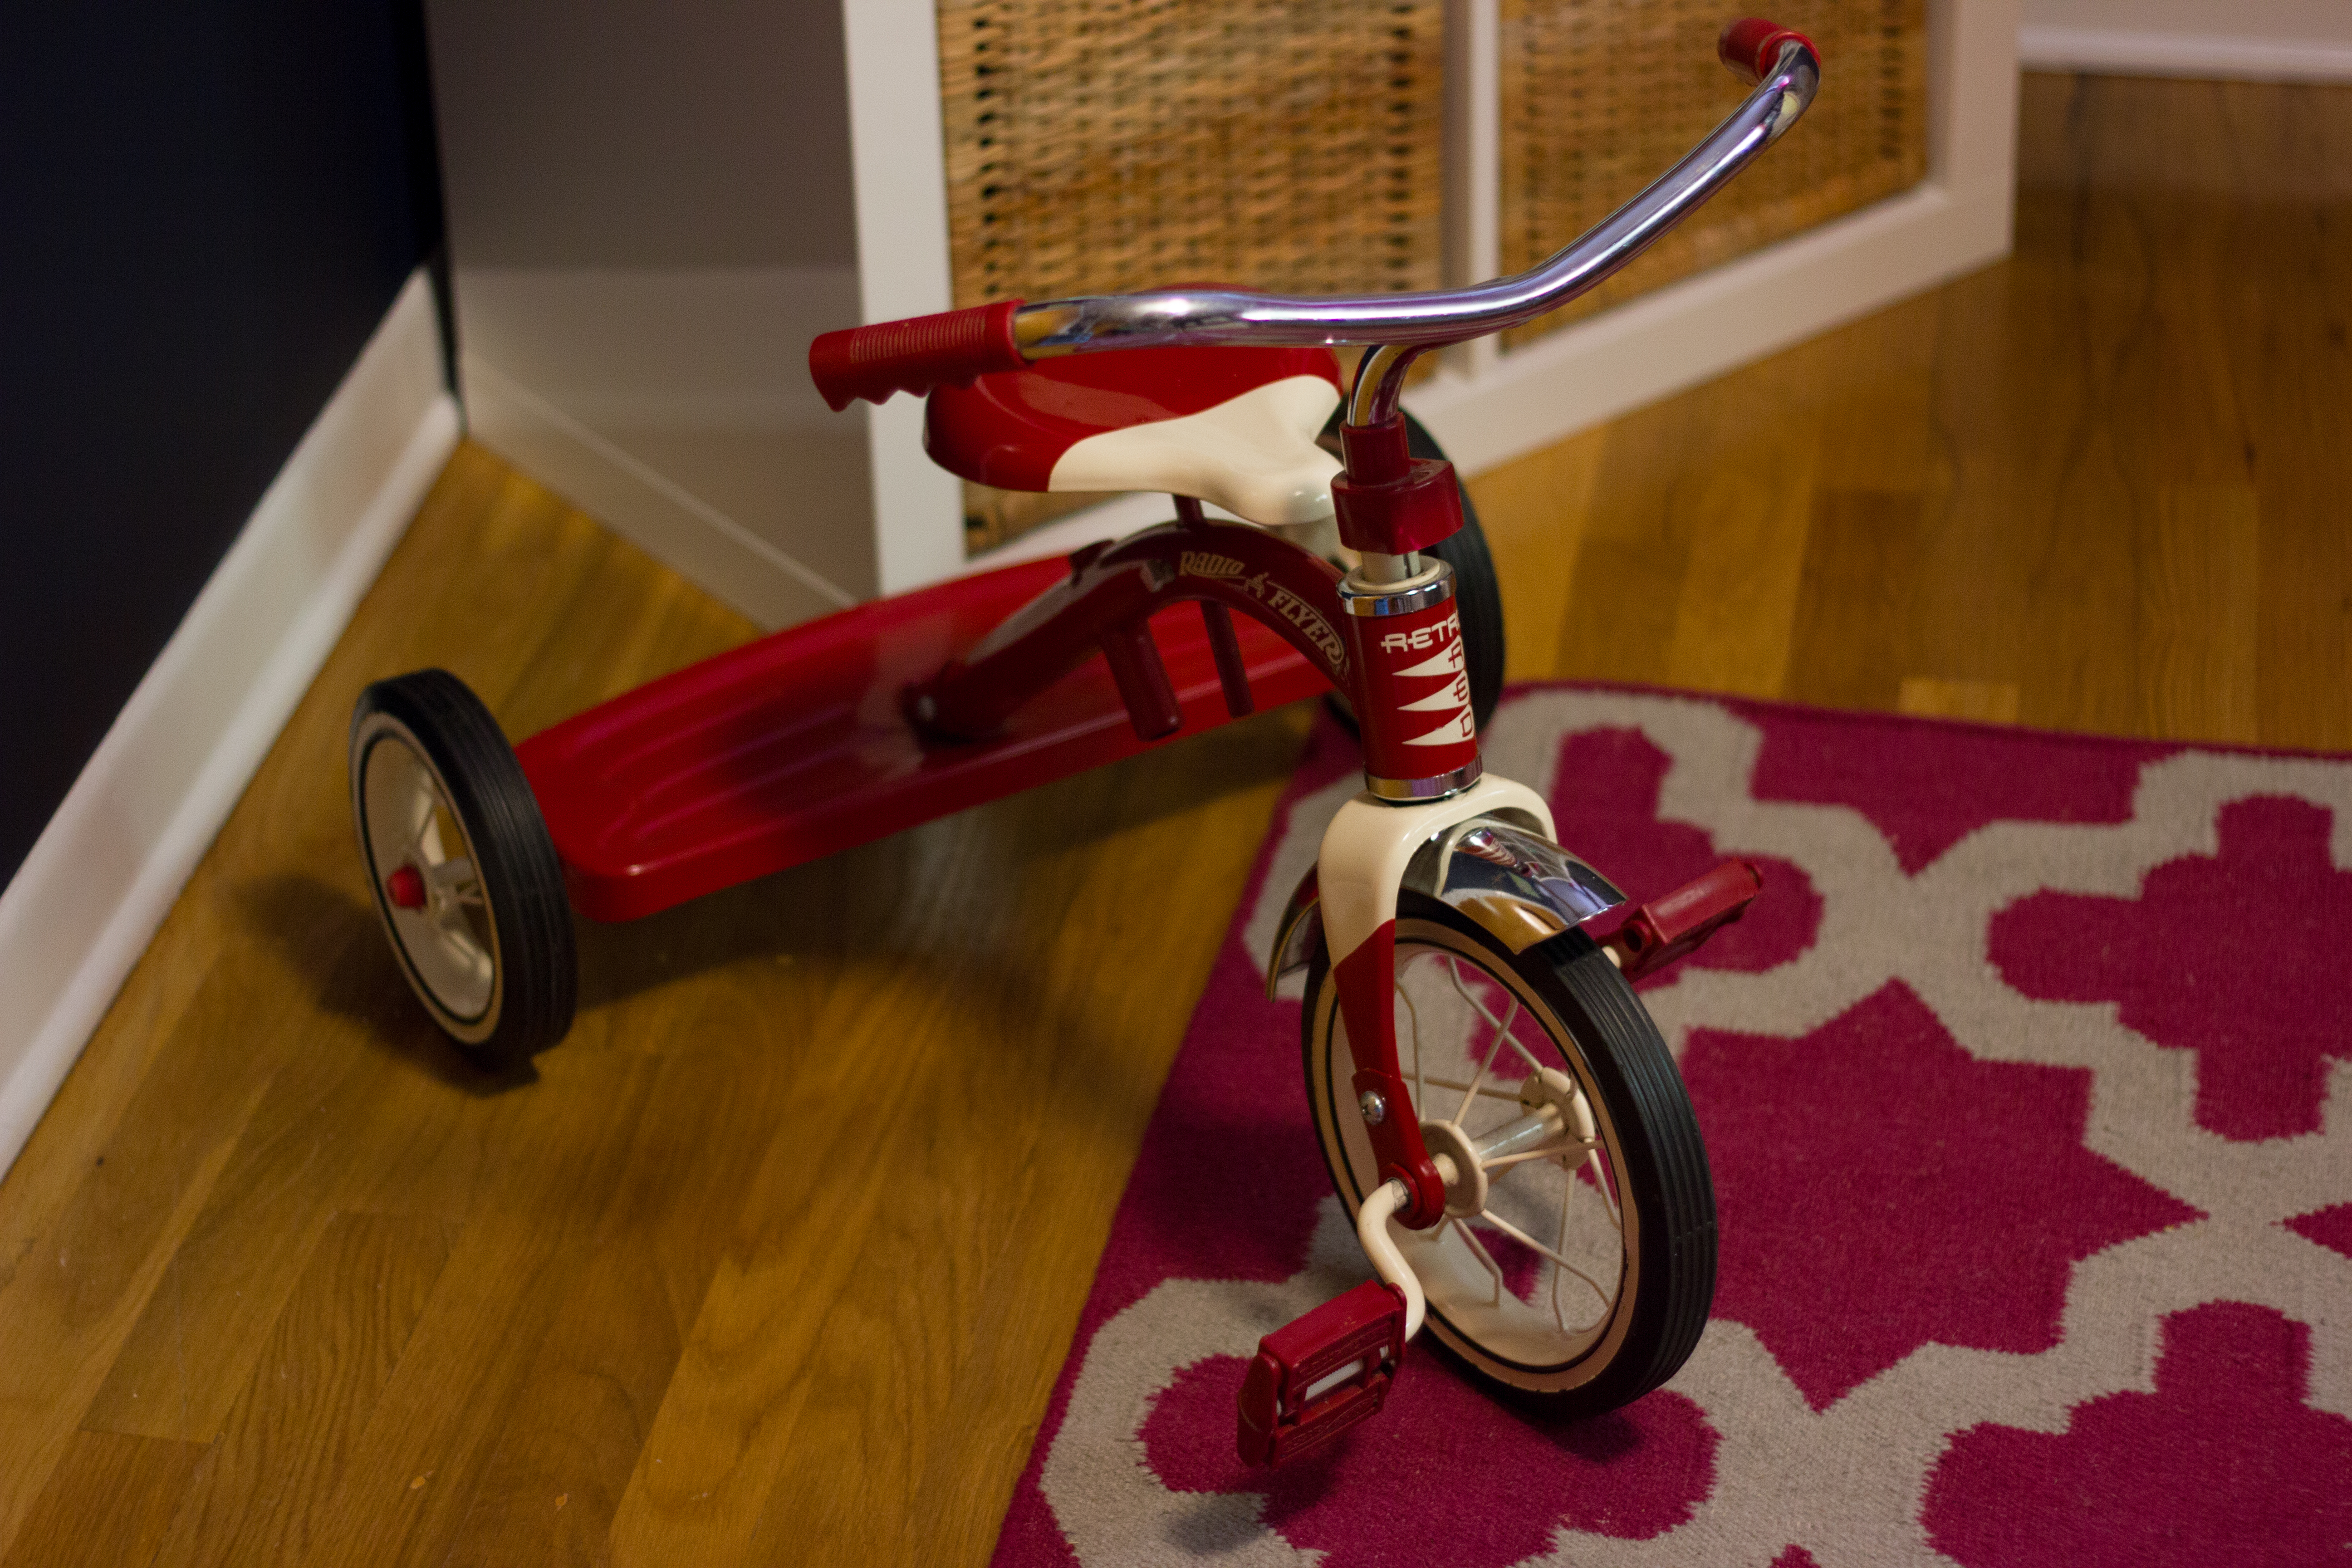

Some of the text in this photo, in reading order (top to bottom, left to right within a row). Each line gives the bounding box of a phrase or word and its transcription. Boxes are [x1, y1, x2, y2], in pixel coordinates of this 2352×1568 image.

[1179, 551, 1344, 665] RADIO FLYER
[1380, 609, 1460, 653] RETR
